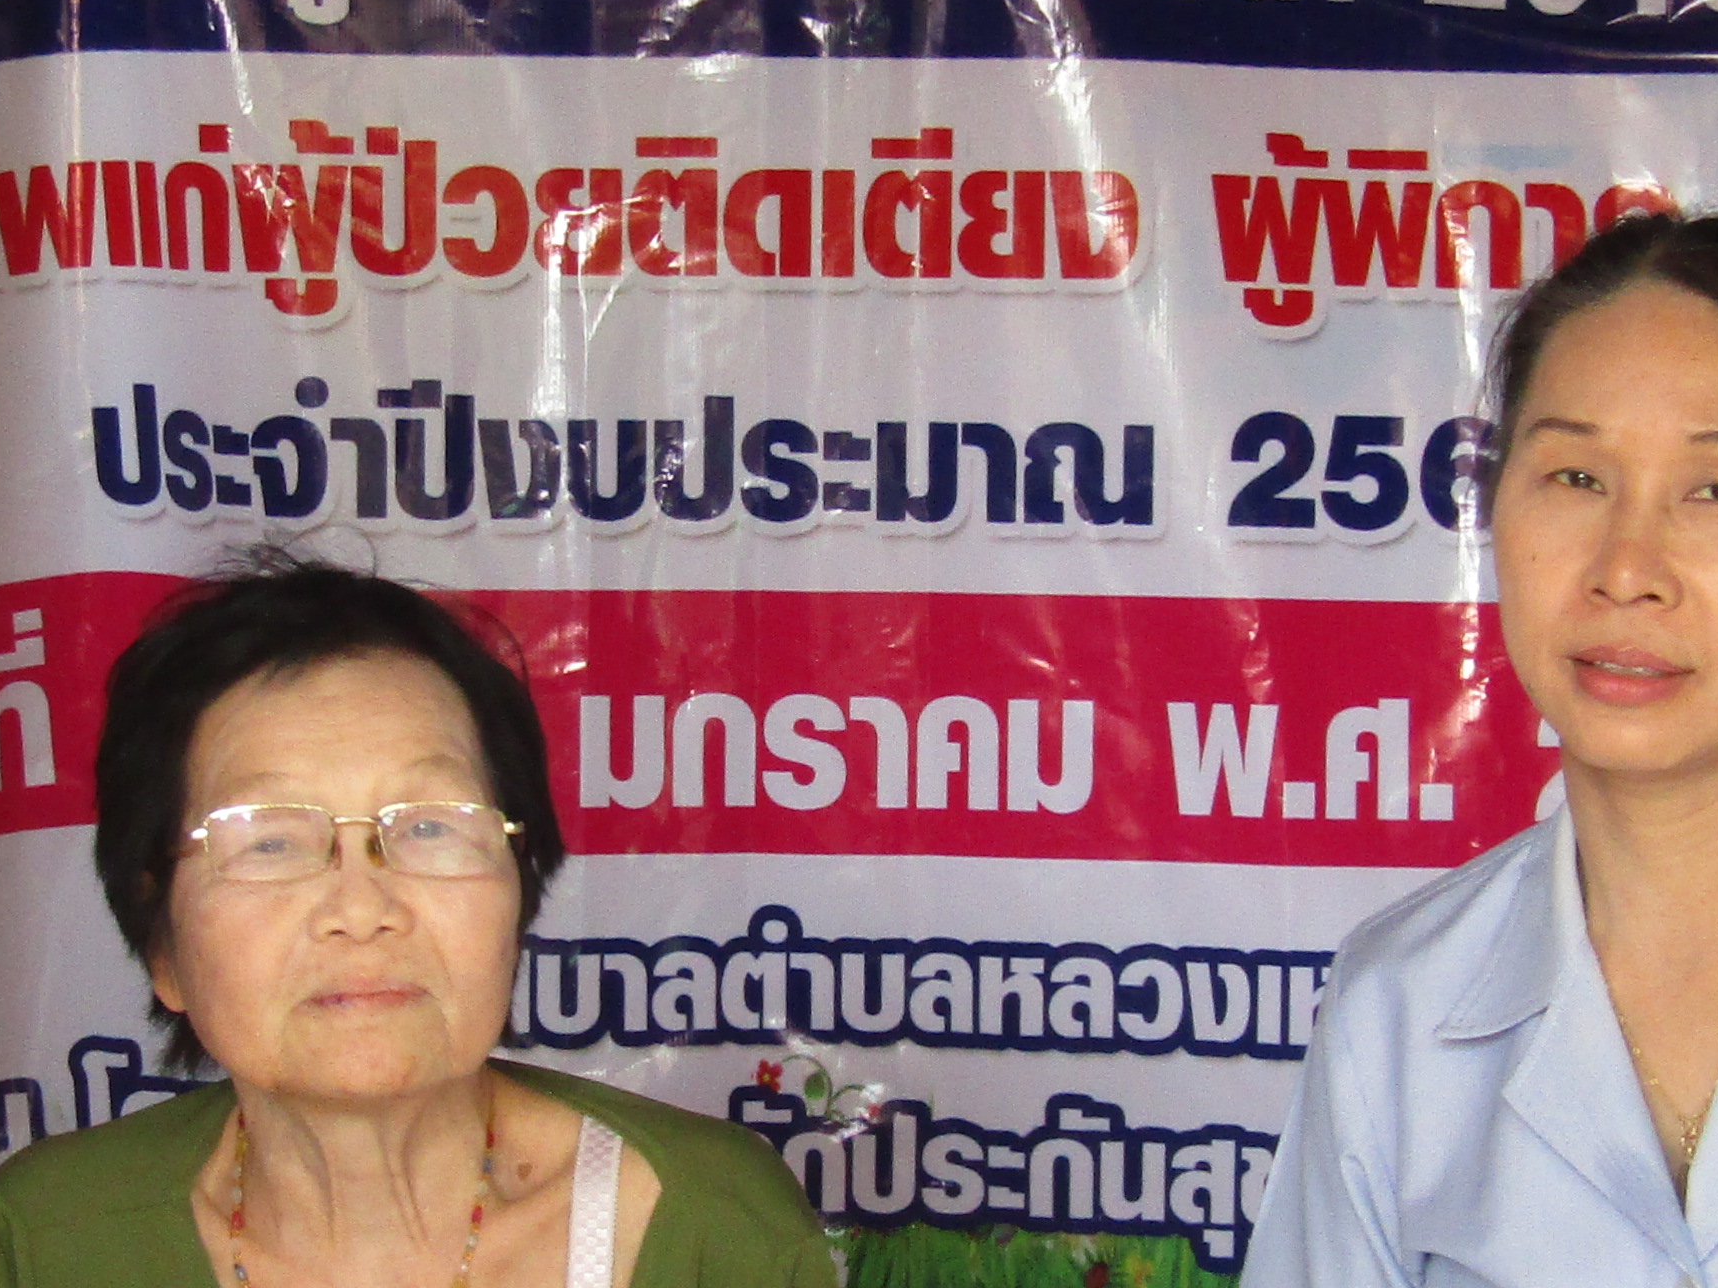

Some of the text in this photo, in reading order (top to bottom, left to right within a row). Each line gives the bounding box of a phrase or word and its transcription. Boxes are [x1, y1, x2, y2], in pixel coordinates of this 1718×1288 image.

[94, 376, 1496, 533] ประจำปีงบประมาณ 256
[576, 693, 1096, 815] มกราคม
[1167, 696, 1455, 823] พ.ศ.
